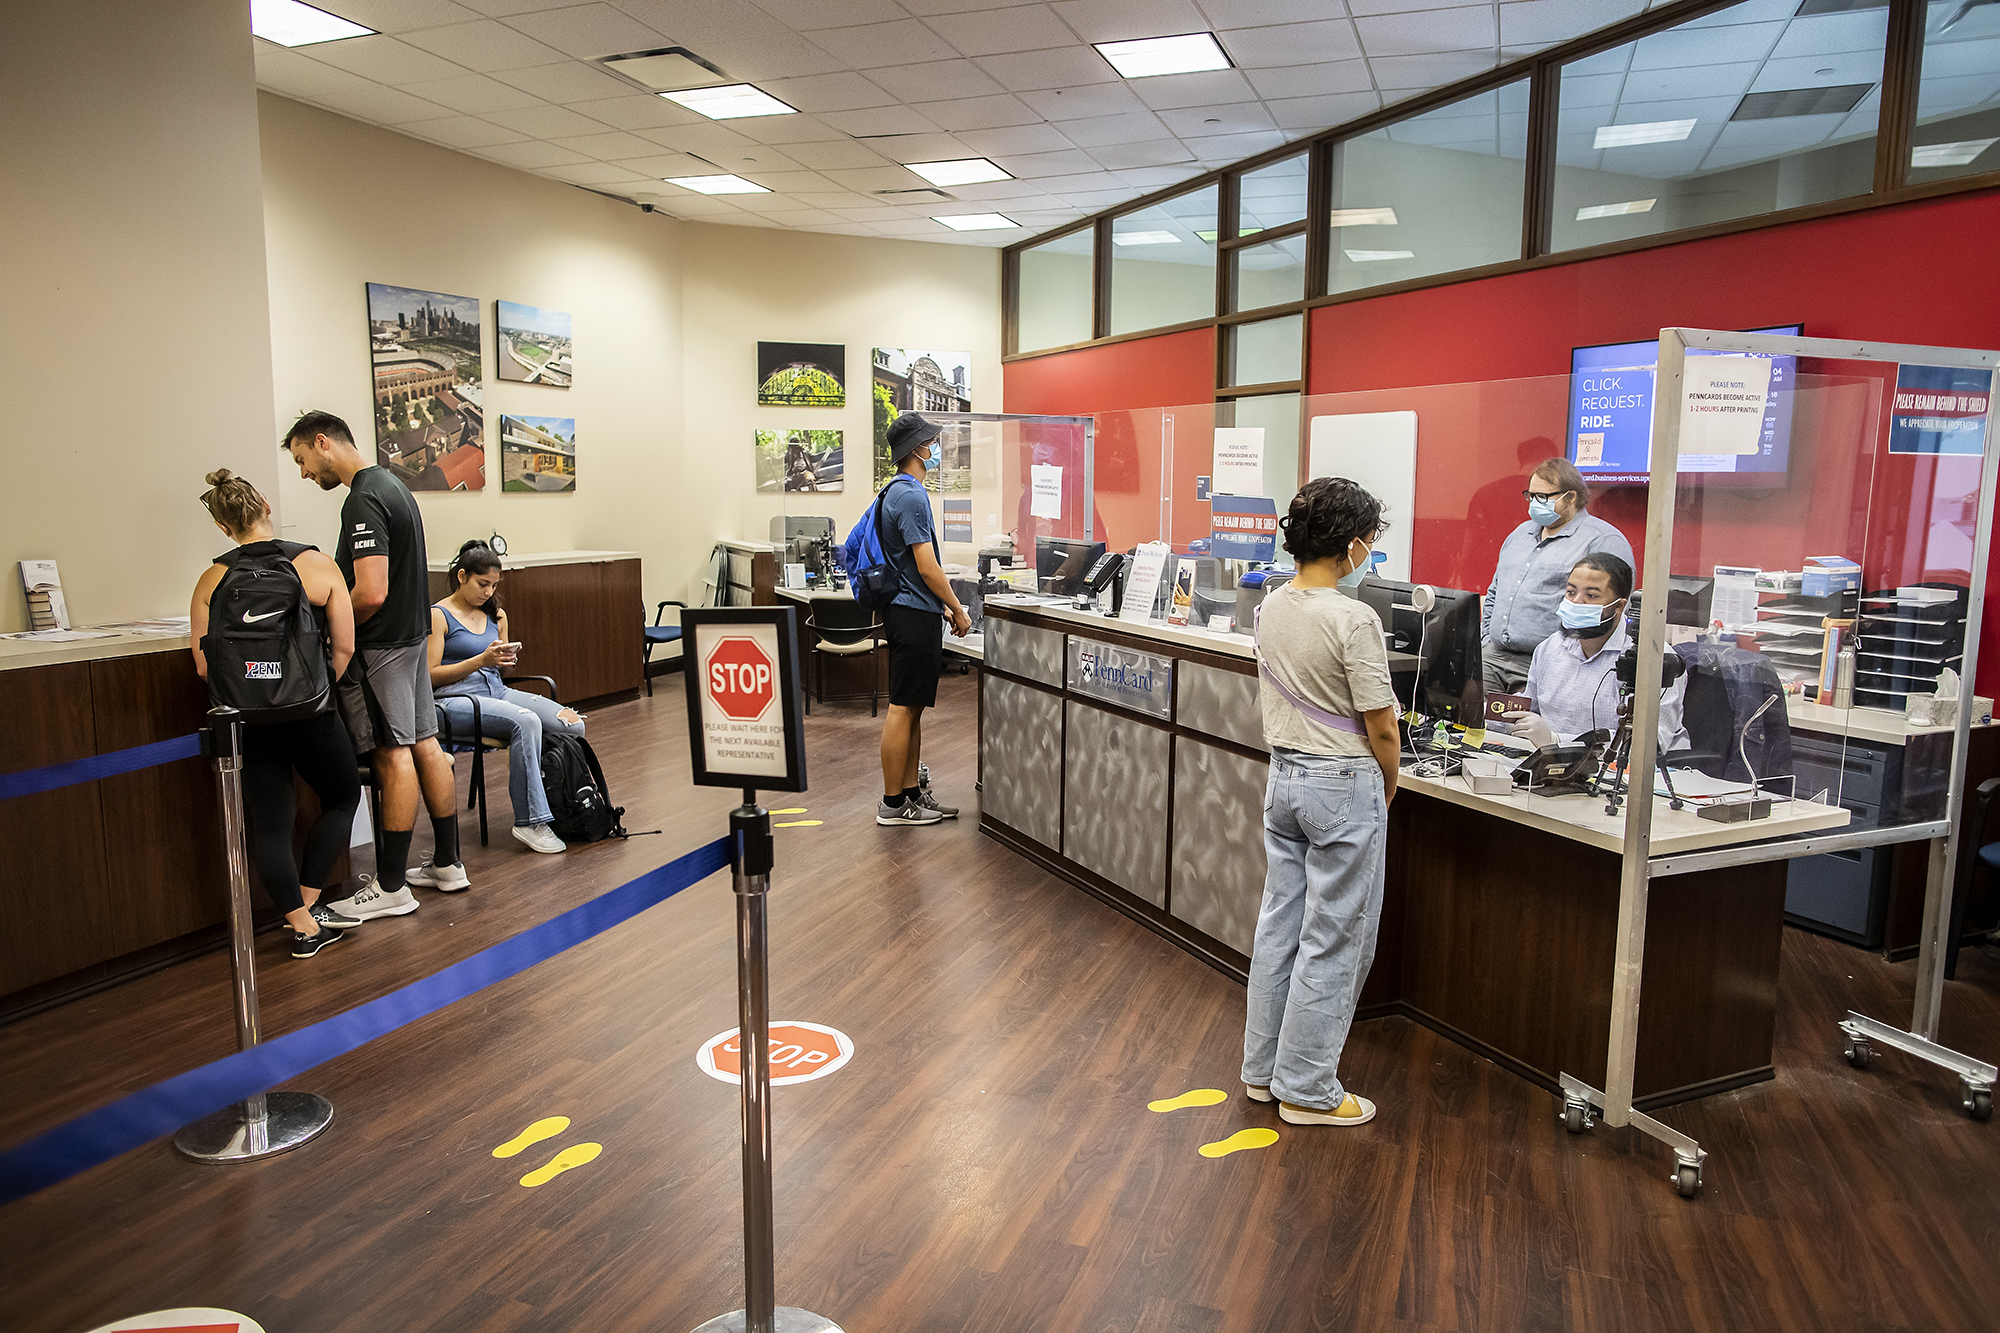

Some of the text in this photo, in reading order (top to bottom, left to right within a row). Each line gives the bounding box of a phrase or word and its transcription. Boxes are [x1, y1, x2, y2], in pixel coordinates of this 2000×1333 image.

[1772, 367, 1782, 376] 04
[1582, 377, 1623, 392] CLICK.
[1581, 394, 1645, 410] REQUEST.
[1688, 392, 1722, 400] PENNCARDS
[1723, 393, 1745, 401] BECOME
[1895, 393, 1987, 412] PLEASE REMAIN BEHIND THE SHIELD
[1700, 405, 1719, 413] HOURS
[1737, 406, 1759, 414] PRINTING
[1580, 415, 1615, 429] RIDE.
[1899, 418, 1979, 430] WE APPRECIATE YOUR COOPERATION
[245, 661, 282, 678] PENN
[1095, 655, 1152, 692] PennCard
[711, 662, 770, 694] STOP
[704, 723, 728, 732] PLEASE
[730, 724, 748, 732] WAIT
[750, 725, 768, 733] HERE
[709, 736, 781, 747] THE NEXT AVAILABLE
[717, 749, 775, 760] REPRESENTATIVE
[723, 1037, 829, 1069] SOP
